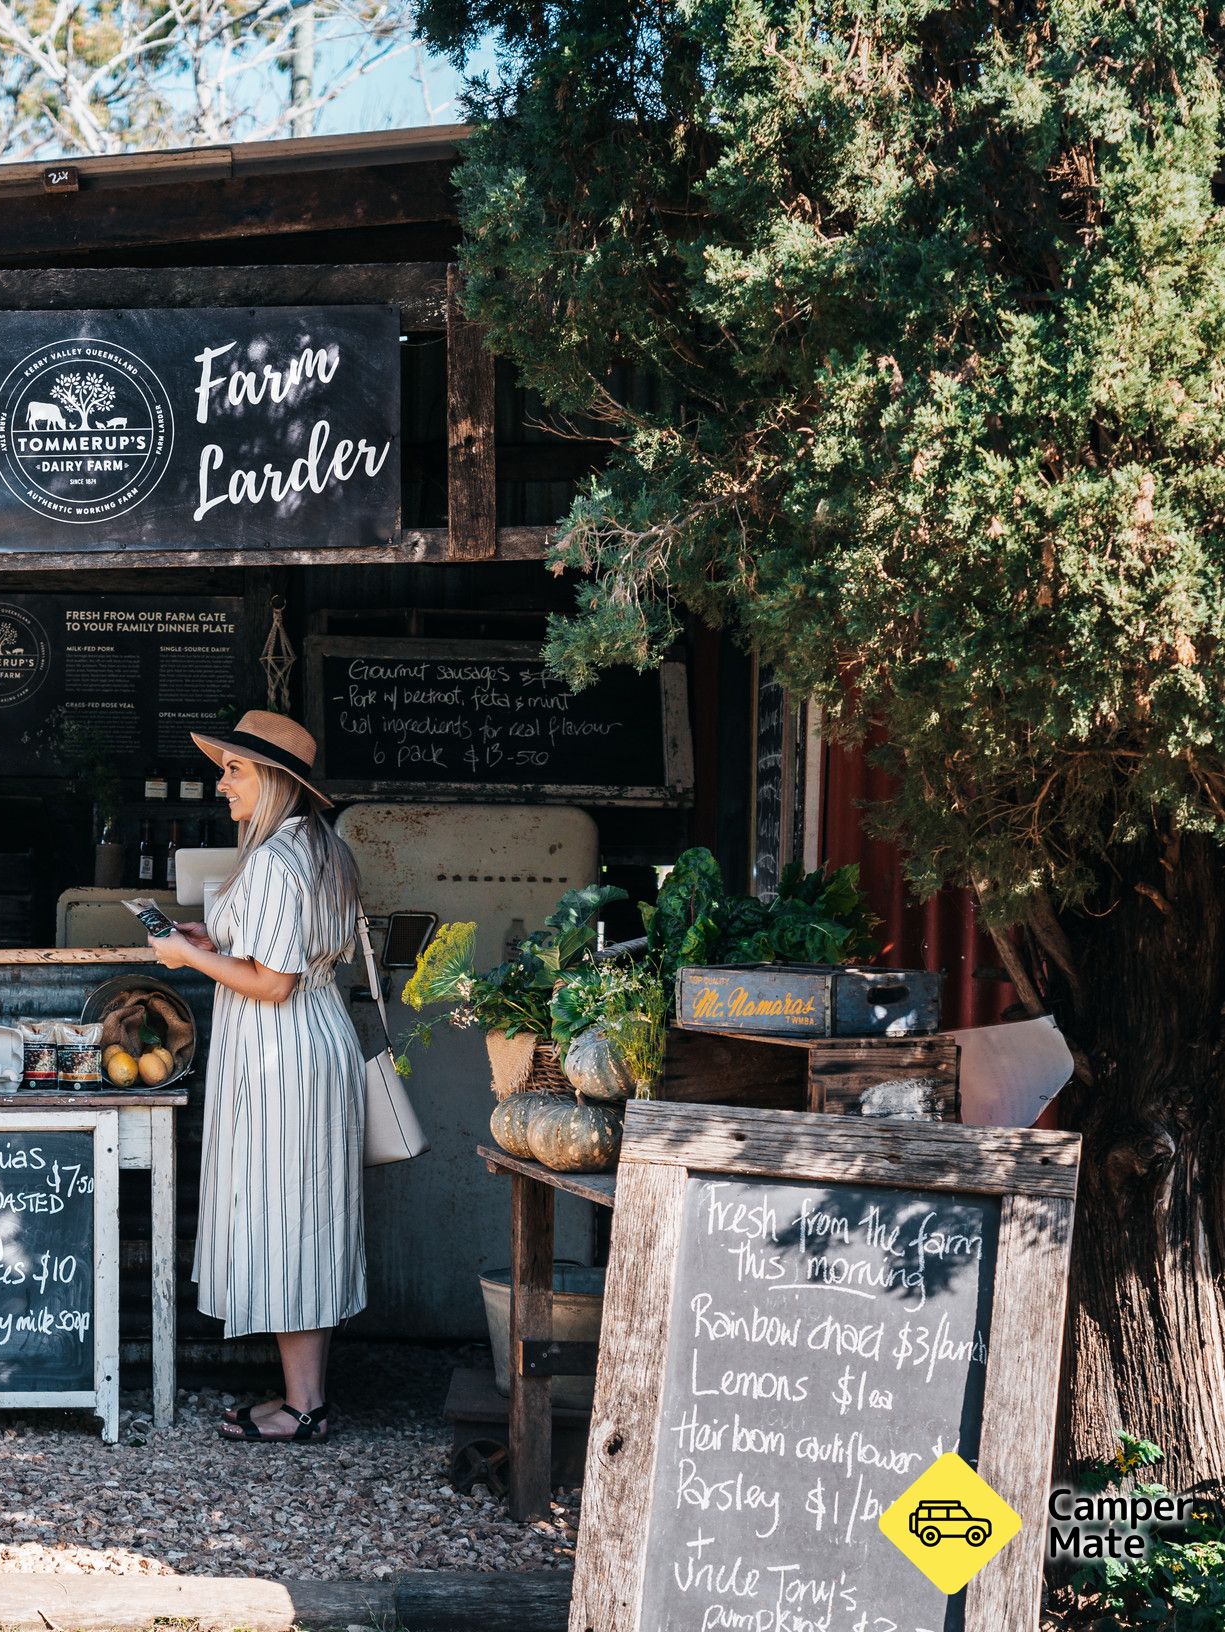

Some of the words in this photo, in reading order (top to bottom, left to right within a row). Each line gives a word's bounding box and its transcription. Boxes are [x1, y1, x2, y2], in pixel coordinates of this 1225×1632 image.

[24, 356, 49, 378] KERRY
[50, 348, 82, 361] VALLEY
[85, 348, 139, 376] QUEENSLAND
[194, 341, 339, 424] Farm
[0, 412, 7, 432] FARM
[155, 404, 165, 434] LARDER
[0, 434, 8, 452] STAY
[18, 436, 146, 452] TOMMERUP'S
[155, 436, 165, 455] FARM
[41, 460, 82, 472] DAIRY
[87, 460, 123, 472] FARM
[193, 420, 391, 522] Larder
[27, 488, 73, 514] AUTHENTIC
[76, 502, 117, 515] WORKING
[118, 487, 139, 505] FARM
[65, 611, 100, 621] FRESH
[103, 611, 135, 621] FROM
[138, 612, 162, 621] OUR
[165, 612, 195, 622] FARM
[198, 613, 226, 622] GATE
[65, 622, 81, 632] TO
[83, 622, 114, 632] YOUR
[116, 623, 154, 632] FAMILY
[157, 624, 200, 633] DINNER
[202, 624, 235, 633] PLATE
[347, 659, 430, 681] Gourmet
[437, 664, 510, 690] sausages
[348, 685, 376, 707] Pork
[470, 685, 510, 710] feta
[528, 693, 573, 711] mint
[382, 716, 473, 744] ingredients
[479, 718, 501, 744] for
[509, 716, 540, 737] real
[548, 716, 623, 746] flavour
[373, 744, 386, 764] 6
[397, 743, 448, 769] pack
[728, 986, 816, 1018] Namaras
[705, 1184, 779, 1243] Fresh
[792, 1198, 850, 1252] from
[909, 1211, 983, 1272] farm
[33, 1250, 77, 1295] $10
[807, 1253, 927, 1313] morning
[55, 1311, 91, 1343] soap
[691, 1292, 801, 1348] Rainbow
[692, 1348, 809, 1402] Lemons
[677, 1458, 780, 1538] Parsley
[675, 1557, 760, 1597] Uncle
[767, 1564, 857, 1611] Tony's
